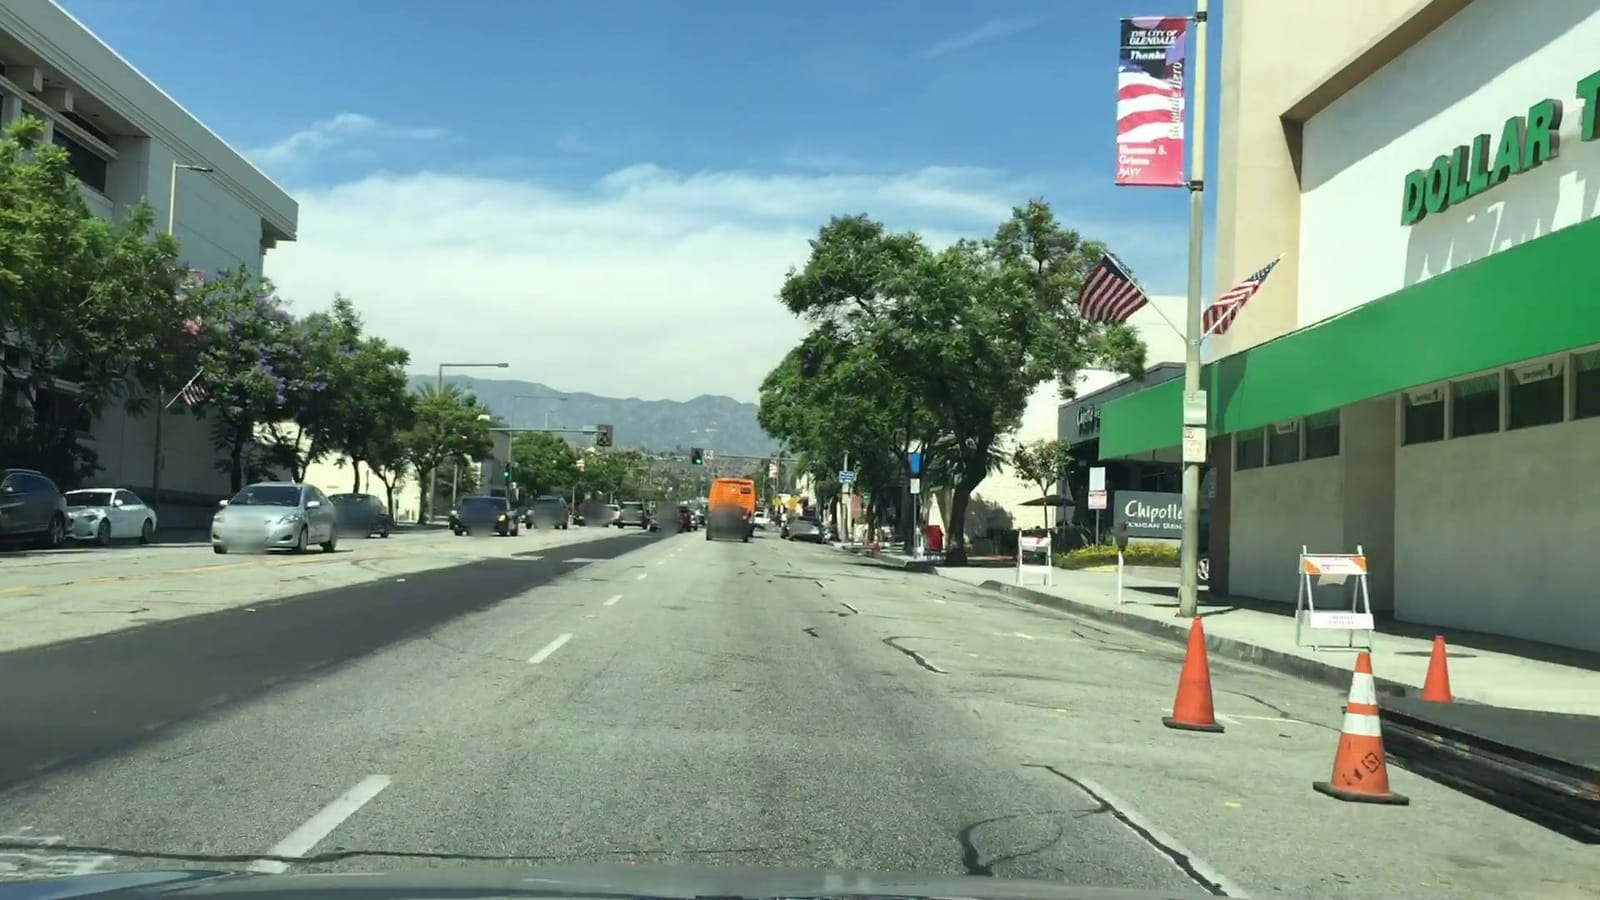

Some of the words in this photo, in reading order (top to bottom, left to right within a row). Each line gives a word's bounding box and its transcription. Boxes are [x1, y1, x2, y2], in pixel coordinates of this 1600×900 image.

[1129, 36, 1177, 45] GLENDALE
[1130, 50, 1166, 60] Thanks
[1401, 98, 1563, 226] DOLLAR
[1125, 500, 1184, 522] Chipotle
